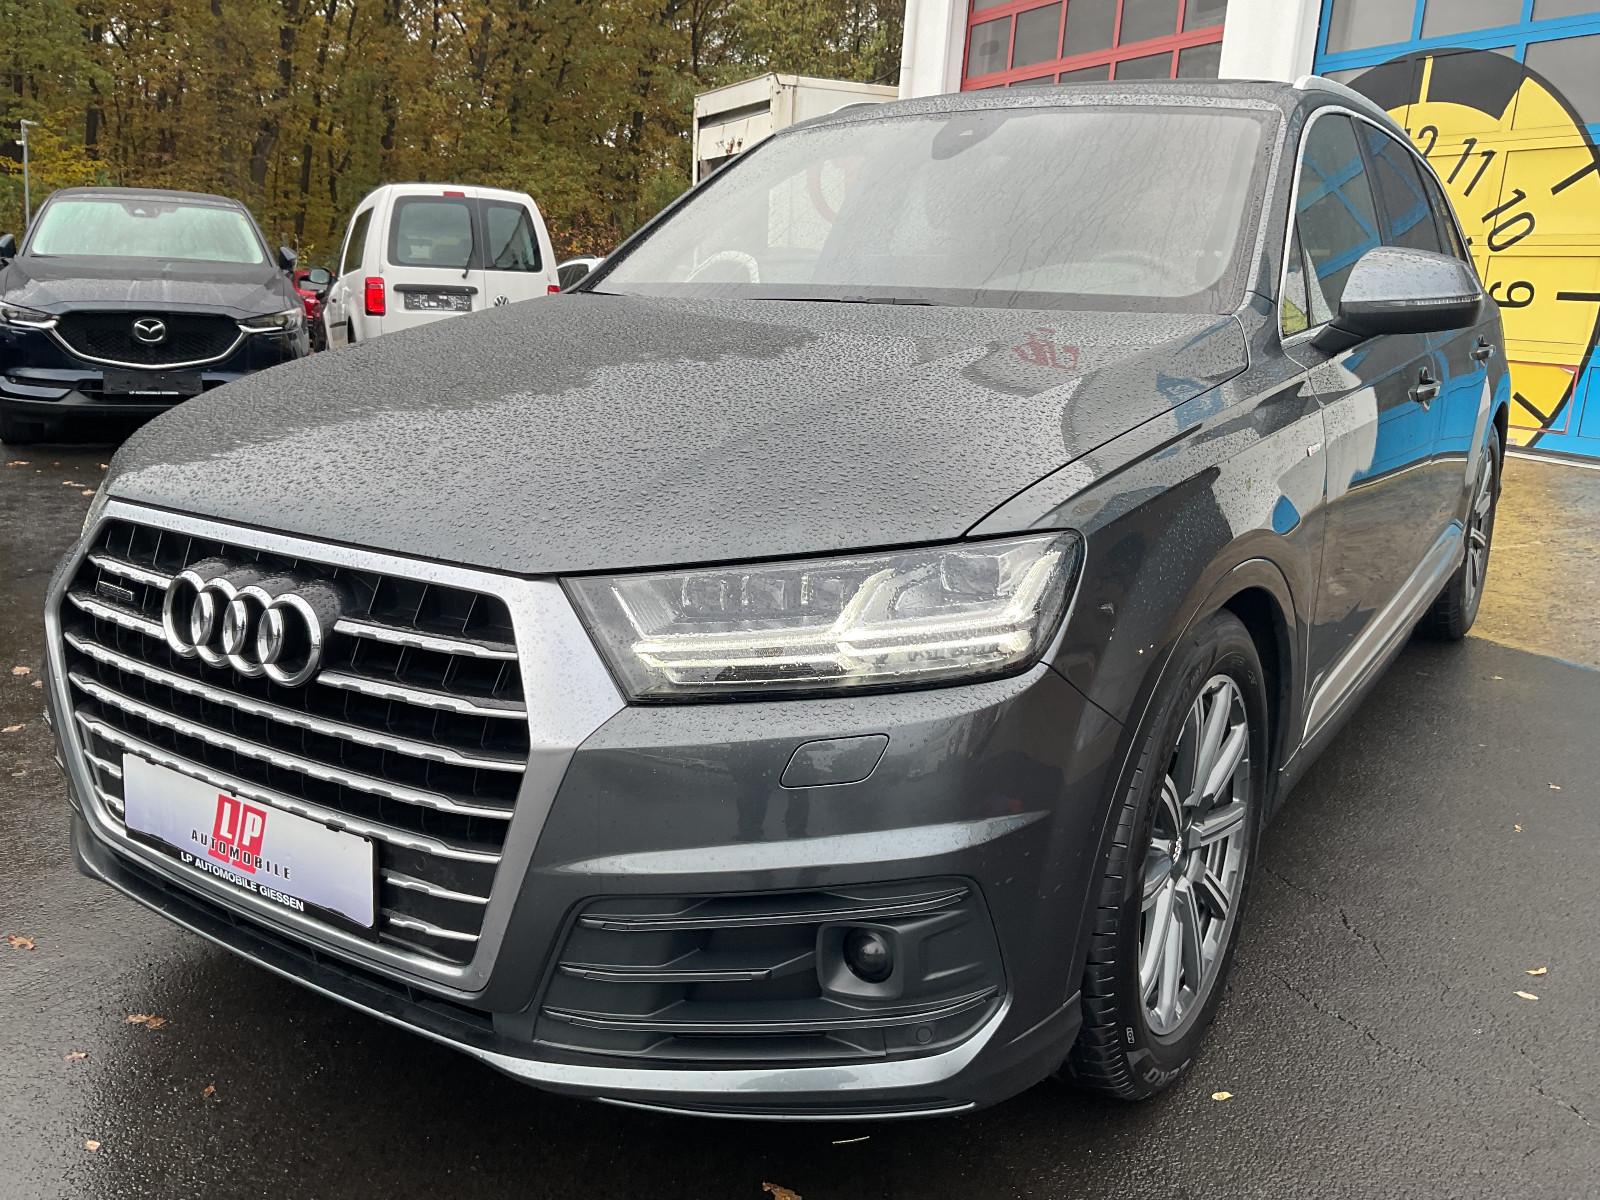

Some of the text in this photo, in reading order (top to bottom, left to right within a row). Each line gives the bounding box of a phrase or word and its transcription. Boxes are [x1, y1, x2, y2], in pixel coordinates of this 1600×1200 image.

[1446, 137, 1498, 198] 11
[1481, 188, 1536, 252] 10
[1488, 280, 1535, 309] 9
[219, 801, 263, 847] LP
[180, 851, 305, 912] LP AUTOMOBILE GIESSEN
[191, 829, 292, 880] AUTOMOBILE
